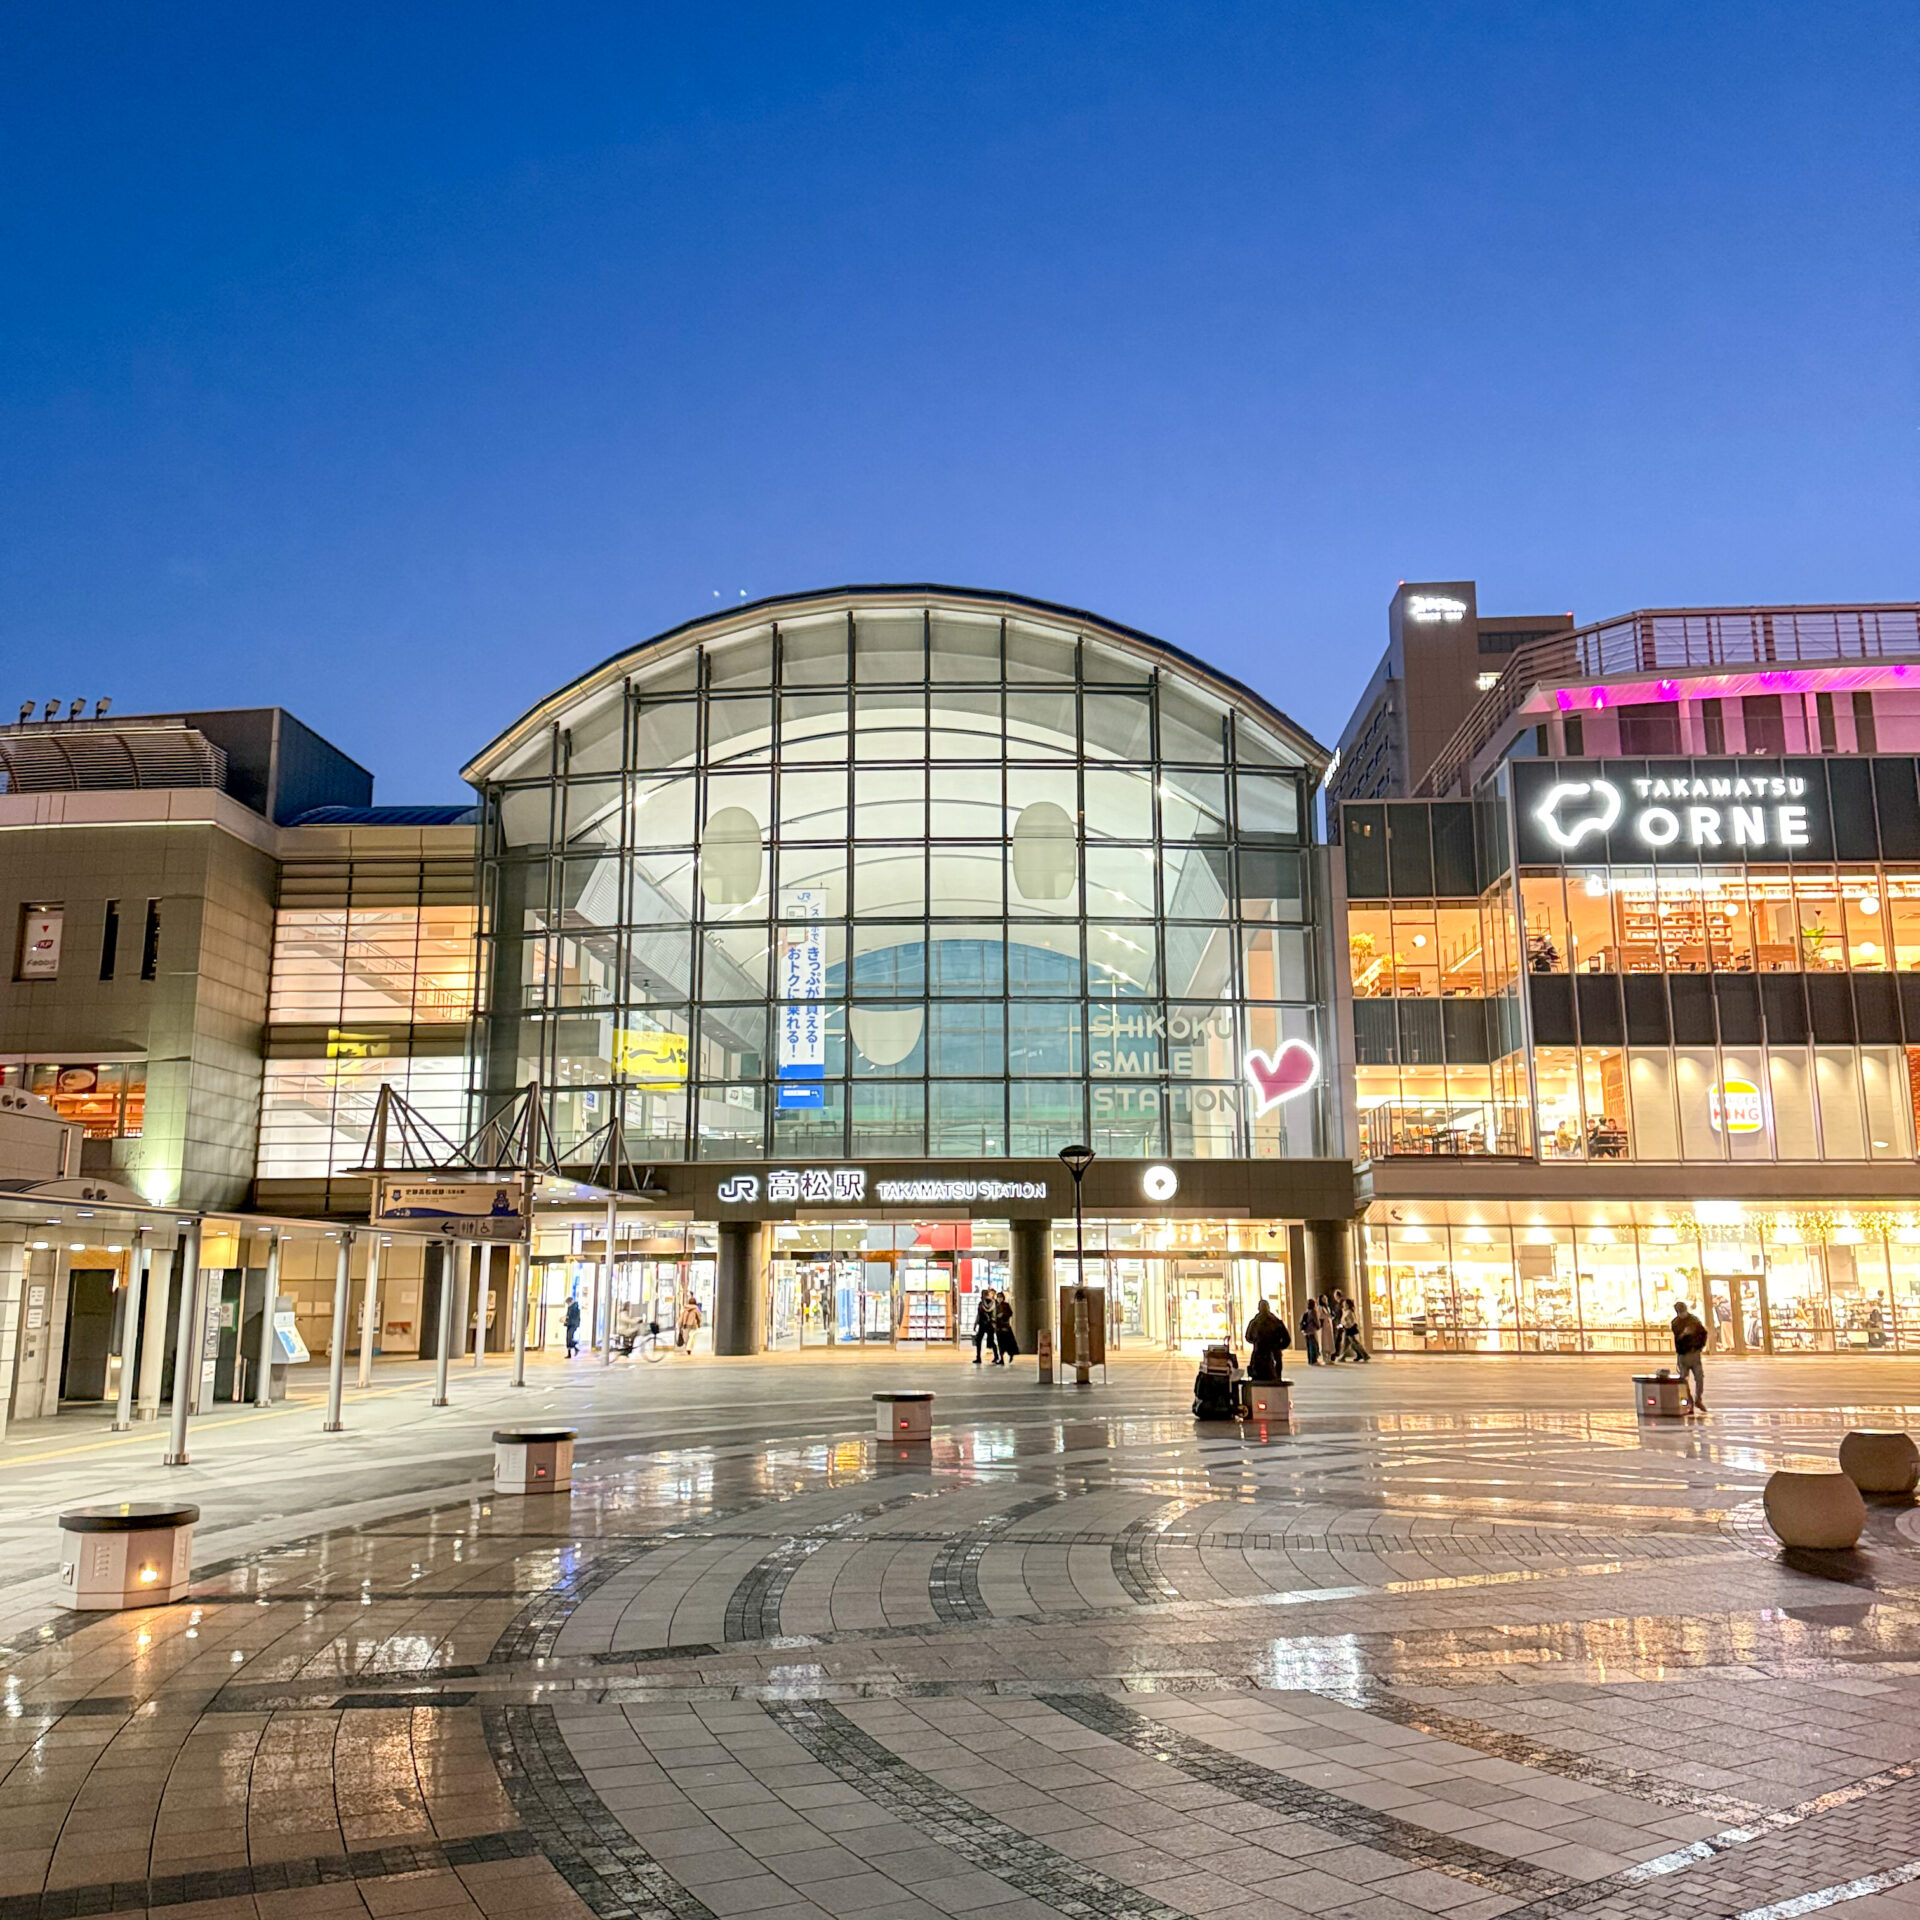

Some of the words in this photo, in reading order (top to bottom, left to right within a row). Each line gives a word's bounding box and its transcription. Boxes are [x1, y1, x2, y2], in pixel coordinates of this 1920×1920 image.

[1635, 777, 1806, 798] TAKAMATSU
[1638, 805, 1811, 847] ORNE
[1092, 1015, 1233, 1039] SHIKOKU
[1092, 1050, 1192, 1075] SMILE
[1094, 1087, 1239, 1113] STATION
[720, 1178, 756, 1200] JR
[767, 1171, 865, 1200] 高松駅
[878, 1183, 974, 1200] TAKAMATSU
[977, 1182, 1047, 1200] STATION
